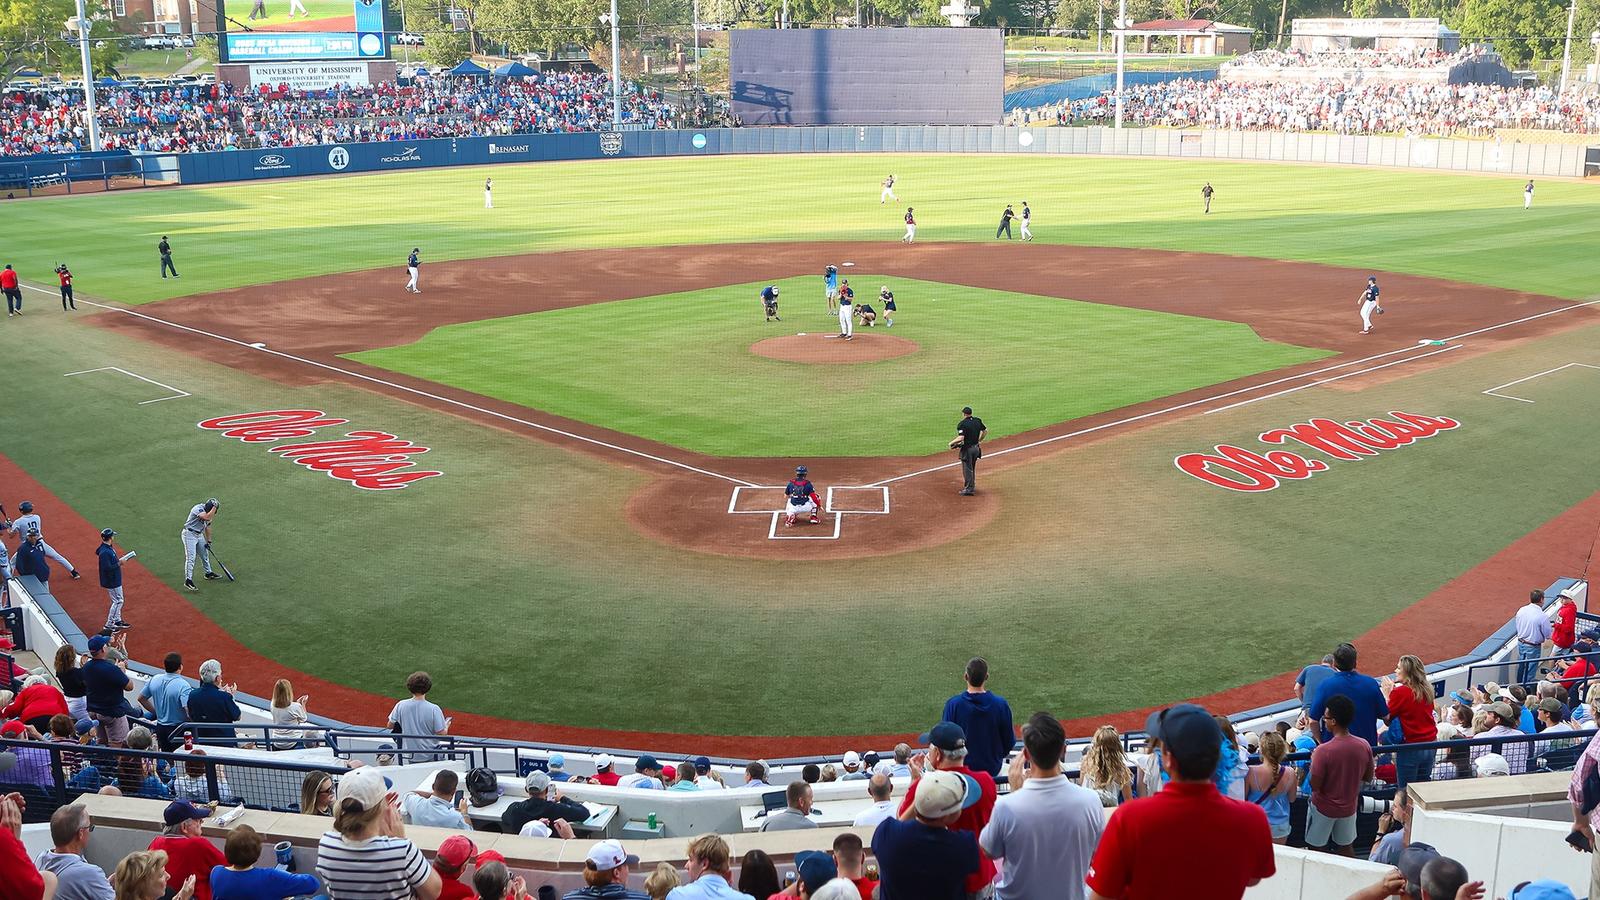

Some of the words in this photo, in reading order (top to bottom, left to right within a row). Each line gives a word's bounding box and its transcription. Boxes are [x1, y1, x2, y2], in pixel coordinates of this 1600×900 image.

[332, 154, 346, 166] 41
[496, 145, 530, 153] RENASANT
[197, 409, 350, 443] Ole
[268, 430, 444, 491] Miss
[1173, 443, 1330, 493] Ole
[1257, 410, 1462, 462] Miss
